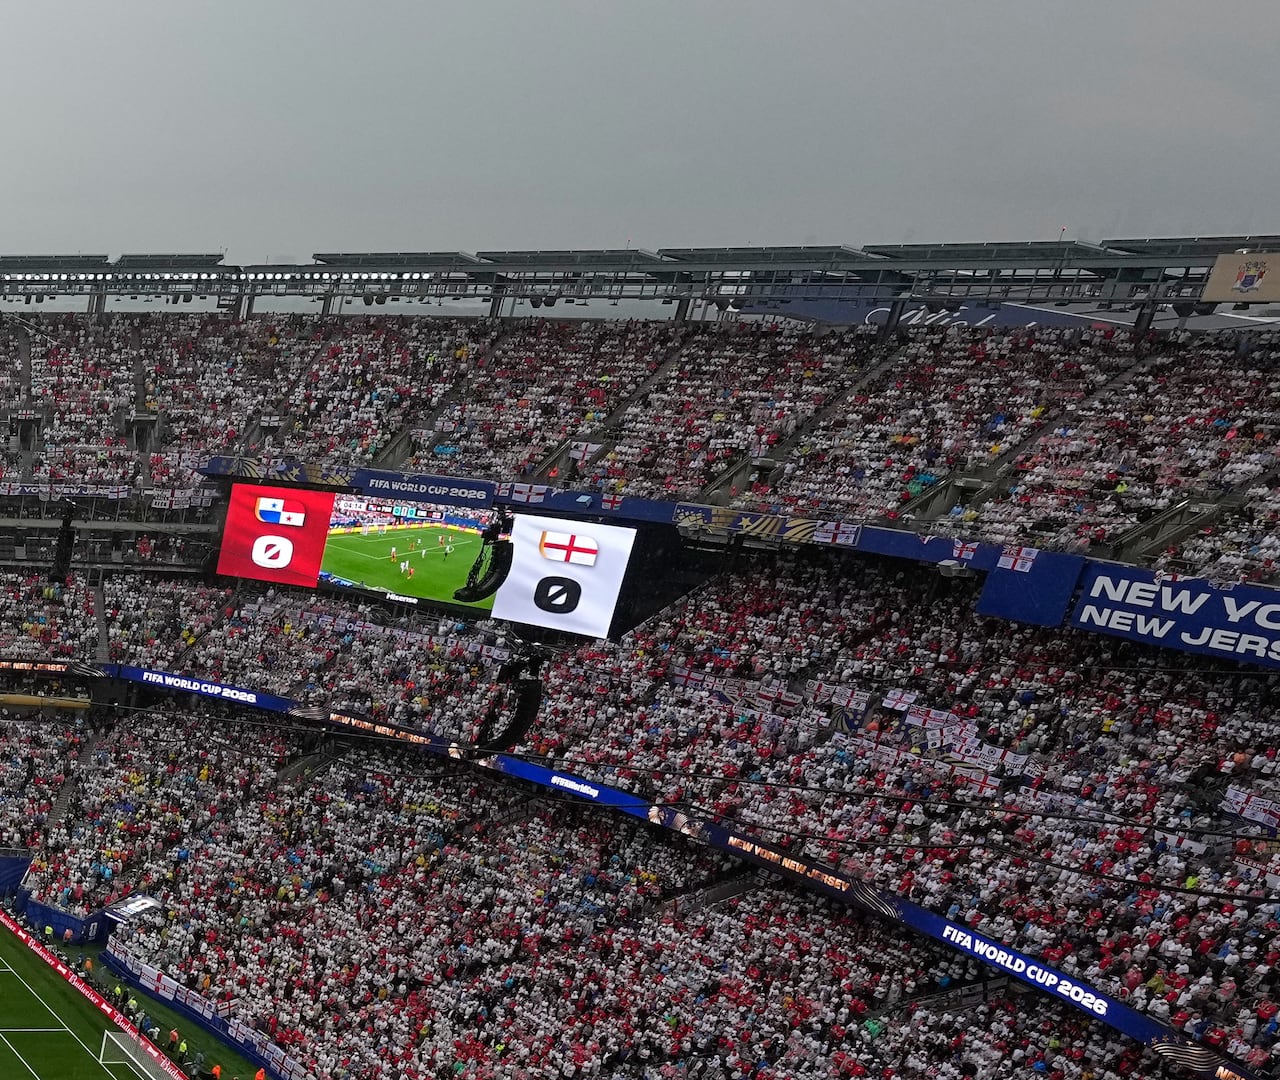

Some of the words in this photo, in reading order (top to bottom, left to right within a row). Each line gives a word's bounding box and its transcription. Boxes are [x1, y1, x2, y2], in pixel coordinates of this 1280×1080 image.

[369, 478, 389, 491] FIFA
[390, 480, 425, 494] WORLD
[426, 486, 449, 498] CUP
[450, 488, 486, 500] 2026
[386, 592, 418, 604] Hisense
[1090, 575, 1211, 615] NEW
[1080, 605, 1176, 638] NEW
[13, 661, 33, 670] NEW
[34, 662, 67, 672] JERSEY
[143, 672, 165, 686] FIFA
[165, 675, 200, 692] WORLD
[201, 683, 221, 694] CUP
[222, 686, 257, 703] 2026
[330, 712, 350, 725] NEW
[351, 717, 374, 731] YORK
[375, 725, 396, 737] NEW
[728, 836, 754, 853] NEW
[754, 844, 782, 864] YORK
[781, 856, 807, 874] NEW
[807, 868, 850, 892] JERSEY
[27, 936, 56, 966] Budweiser
[942, 925, 972, 949] FIFA
[974, 938, 1026, 973] WORLD
[1026, 965, 1059, 987] CUP
[1058, 979, 1109, 1016] 2026
[68, 971, 99, 1004] Budweiser
